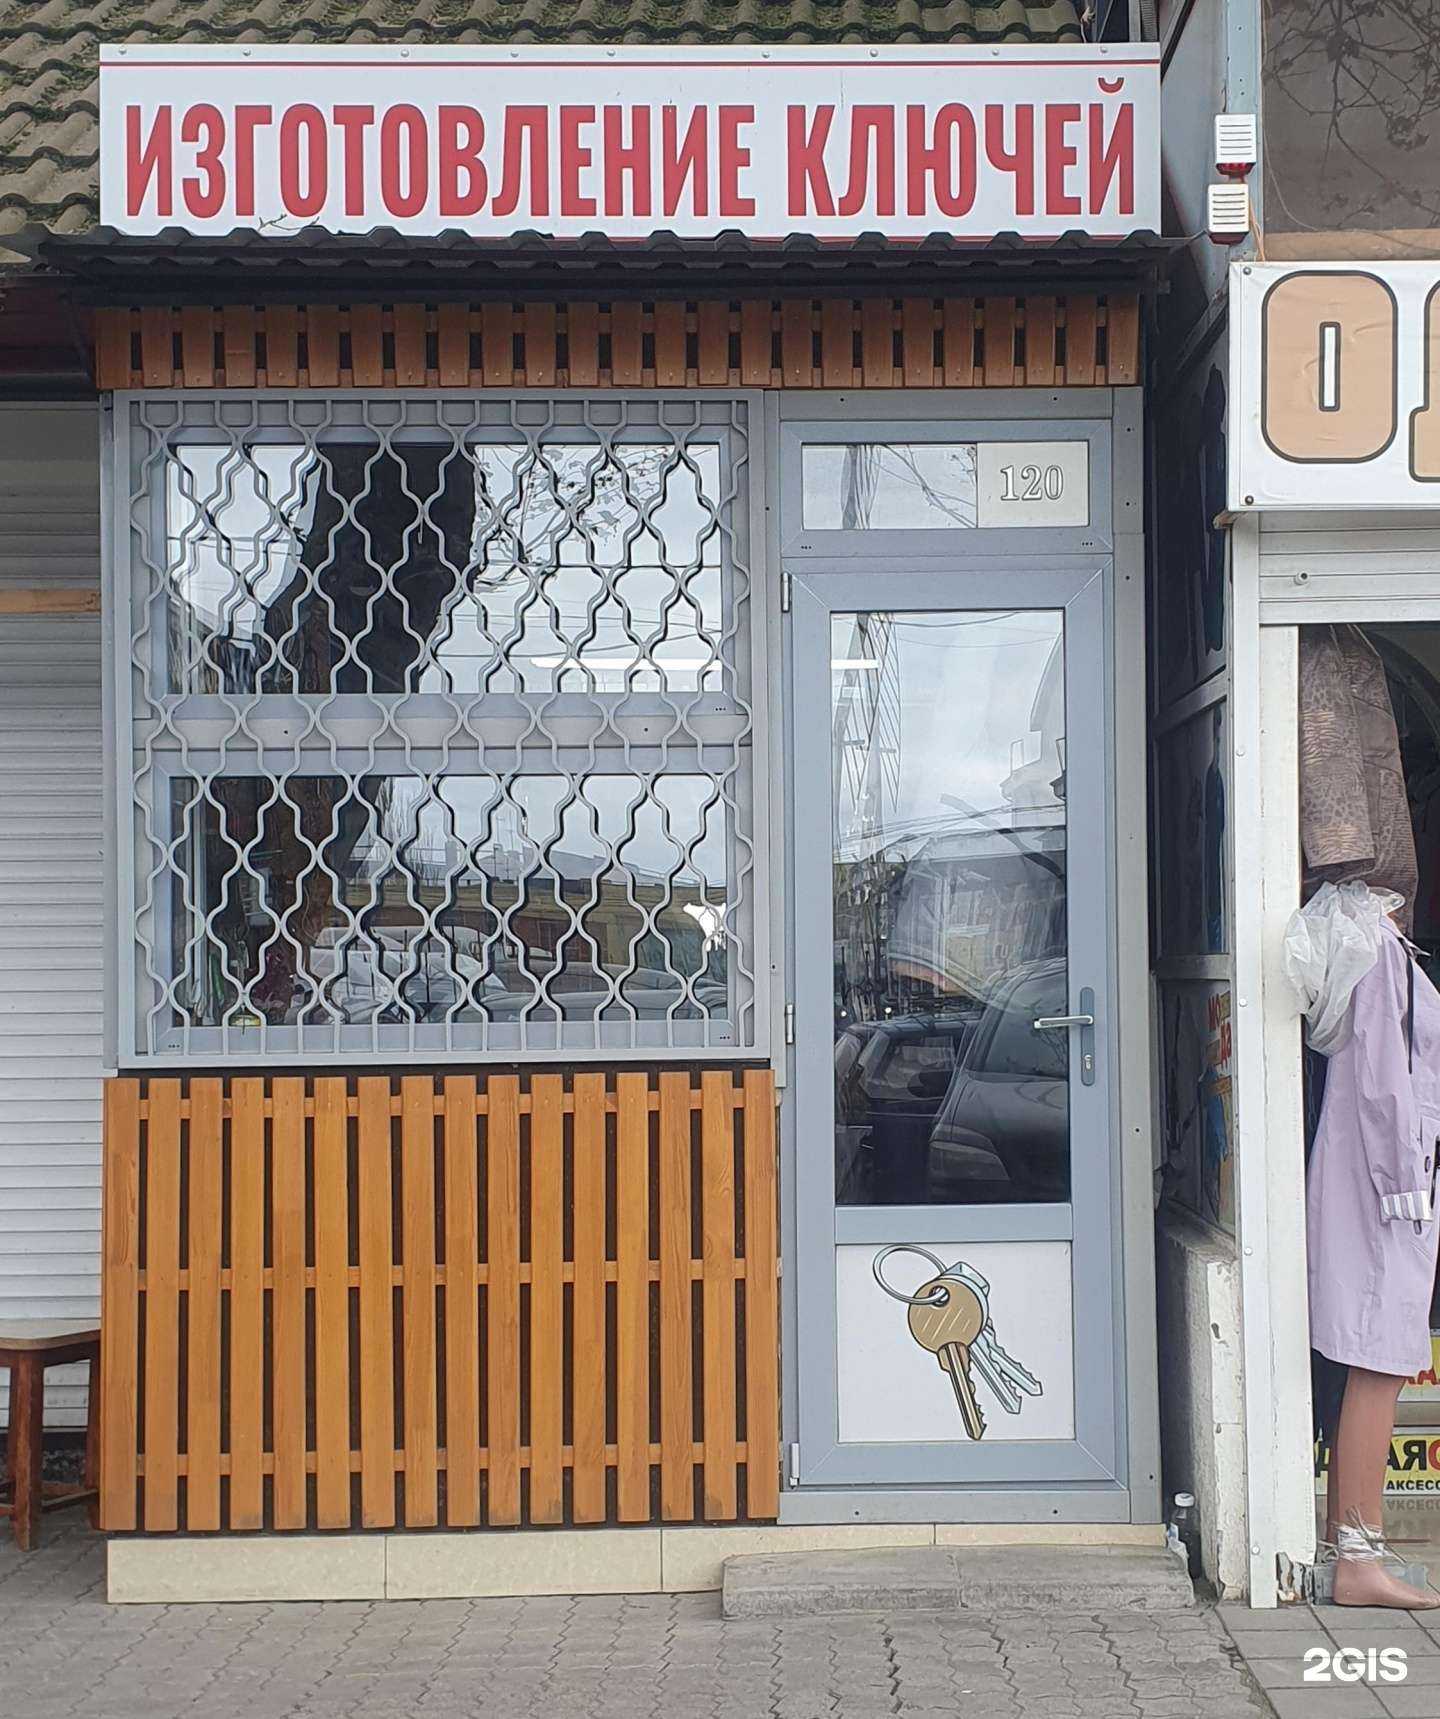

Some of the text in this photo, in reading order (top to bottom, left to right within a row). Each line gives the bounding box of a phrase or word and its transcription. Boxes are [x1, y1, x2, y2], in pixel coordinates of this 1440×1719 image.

[126, 76, 1135, 218] ИЗГОТОВЛЕНИЕ КЛЮЧЕЙ
[1261, 270, 1440, 482] О
[1000, 464, 1064, 501] 120
